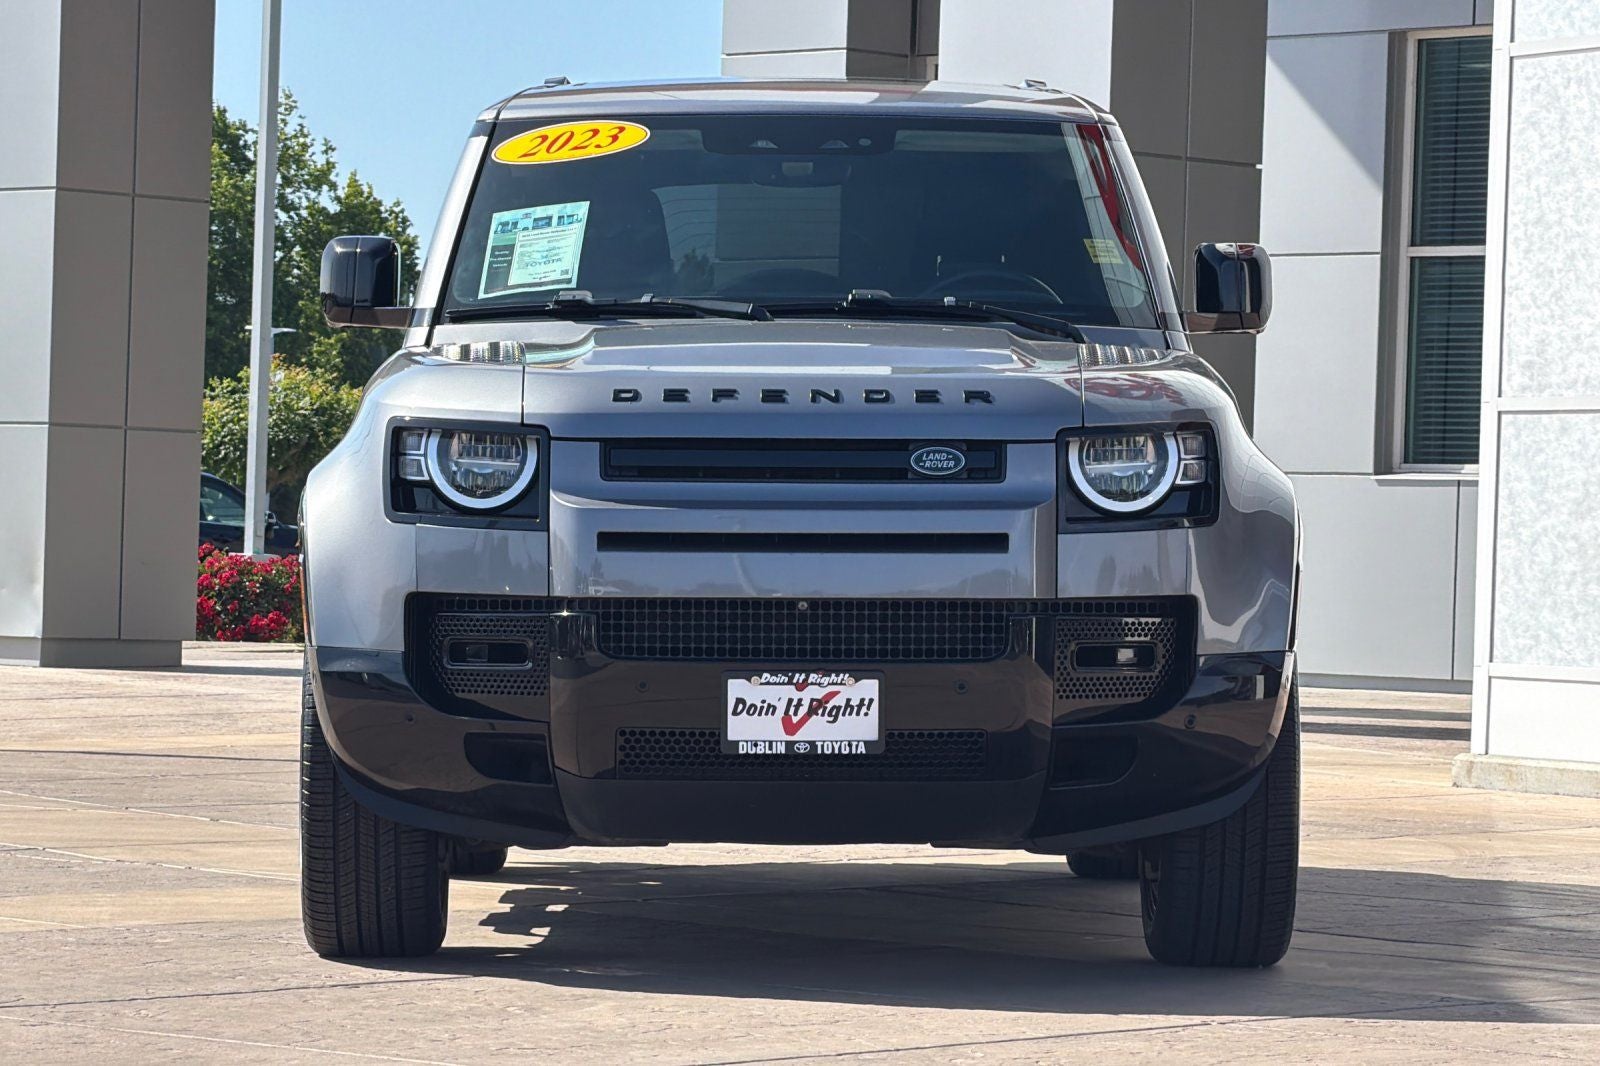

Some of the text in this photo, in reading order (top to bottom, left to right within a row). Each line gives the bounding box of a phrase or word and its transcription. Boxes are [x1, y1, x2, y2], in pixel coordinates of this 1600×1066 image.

[517, 126, 626, 159] 2023
[612, 388, 994, 403] DEFENDER
[760, 672, 850, 688] Doin' It Right!
[731, 697, 875, 724] Doin' It Right!
[738, 741, 867, 755] DUBLIN TOYOTA
